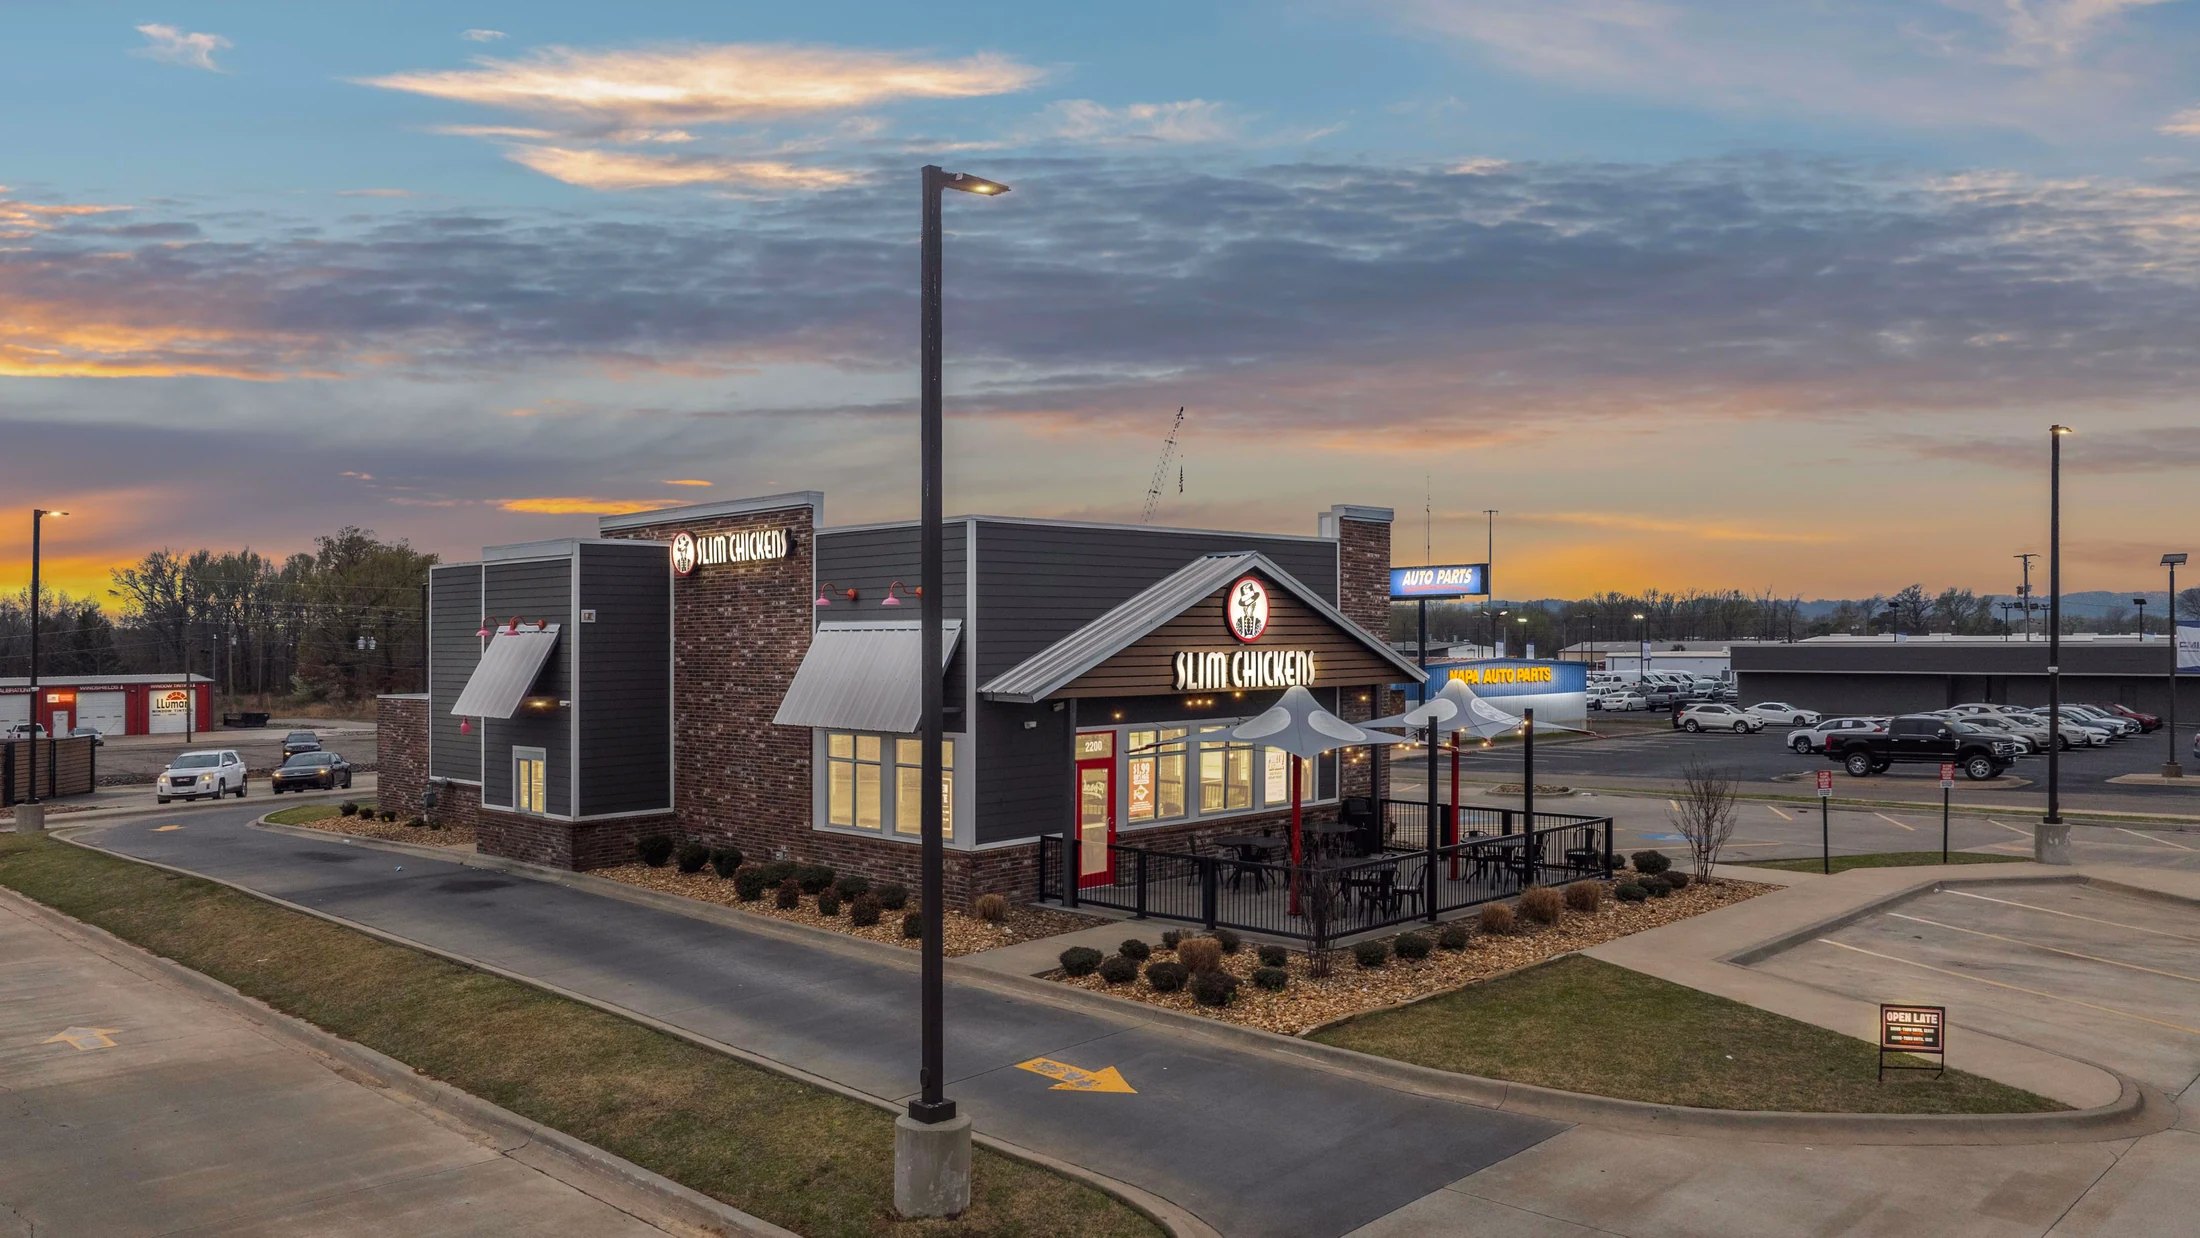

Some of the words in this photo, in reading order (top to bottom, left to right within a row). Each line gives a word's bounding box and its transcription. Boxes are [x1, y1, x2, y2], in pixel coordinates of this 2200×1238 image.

[697, 536, 727, 565] SLIM
[730, 529, 787, 562] CHICKENS
[1402, 569, 1434, 586] AUTO
[1436, 568, 1473, 584] PARTS
[1176, 651, 1227, 690] SLIM
[1232, 650, 1316, 688] CHICKENS
[1482, 668, 1514, 684] AUTO
[1516, 667, 1552, 682] PARTS
[1085, 741, 1103, 752] 2200
[1133, 763, 1150, 774] $1.99
[1886, 1011, 1912, 1022] OPEN
[1913, 1012, 1938, 1024] LATE
